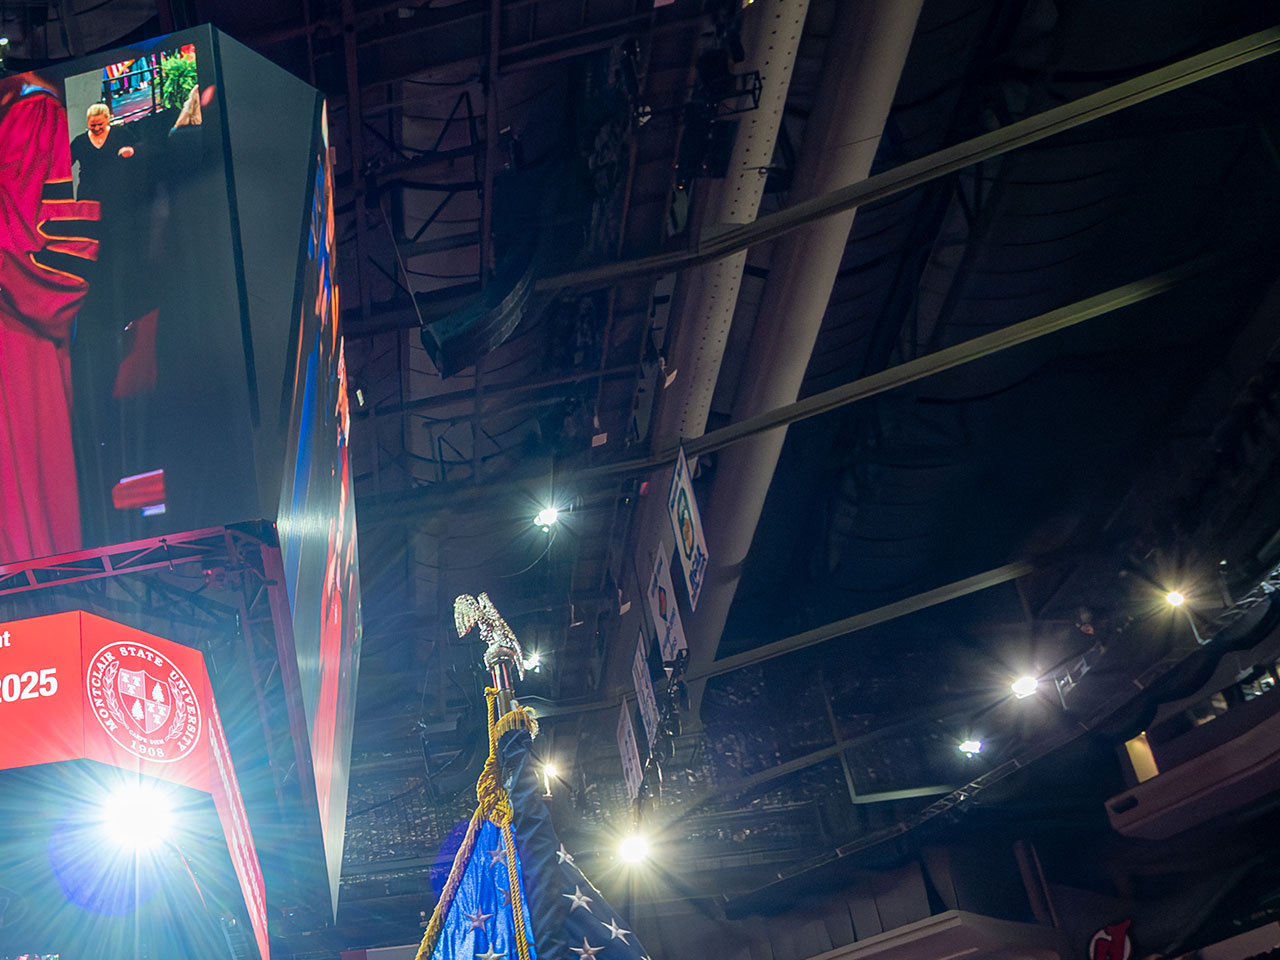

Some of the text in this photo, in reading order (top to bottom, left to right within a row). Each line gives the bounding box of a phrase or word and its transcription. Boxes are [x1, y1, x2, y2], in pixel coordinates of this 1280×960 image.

[92, 647, 196, 752] MONTCLAIR STATE UNIVERSITY
[130, 740, 164, 758] 1908
